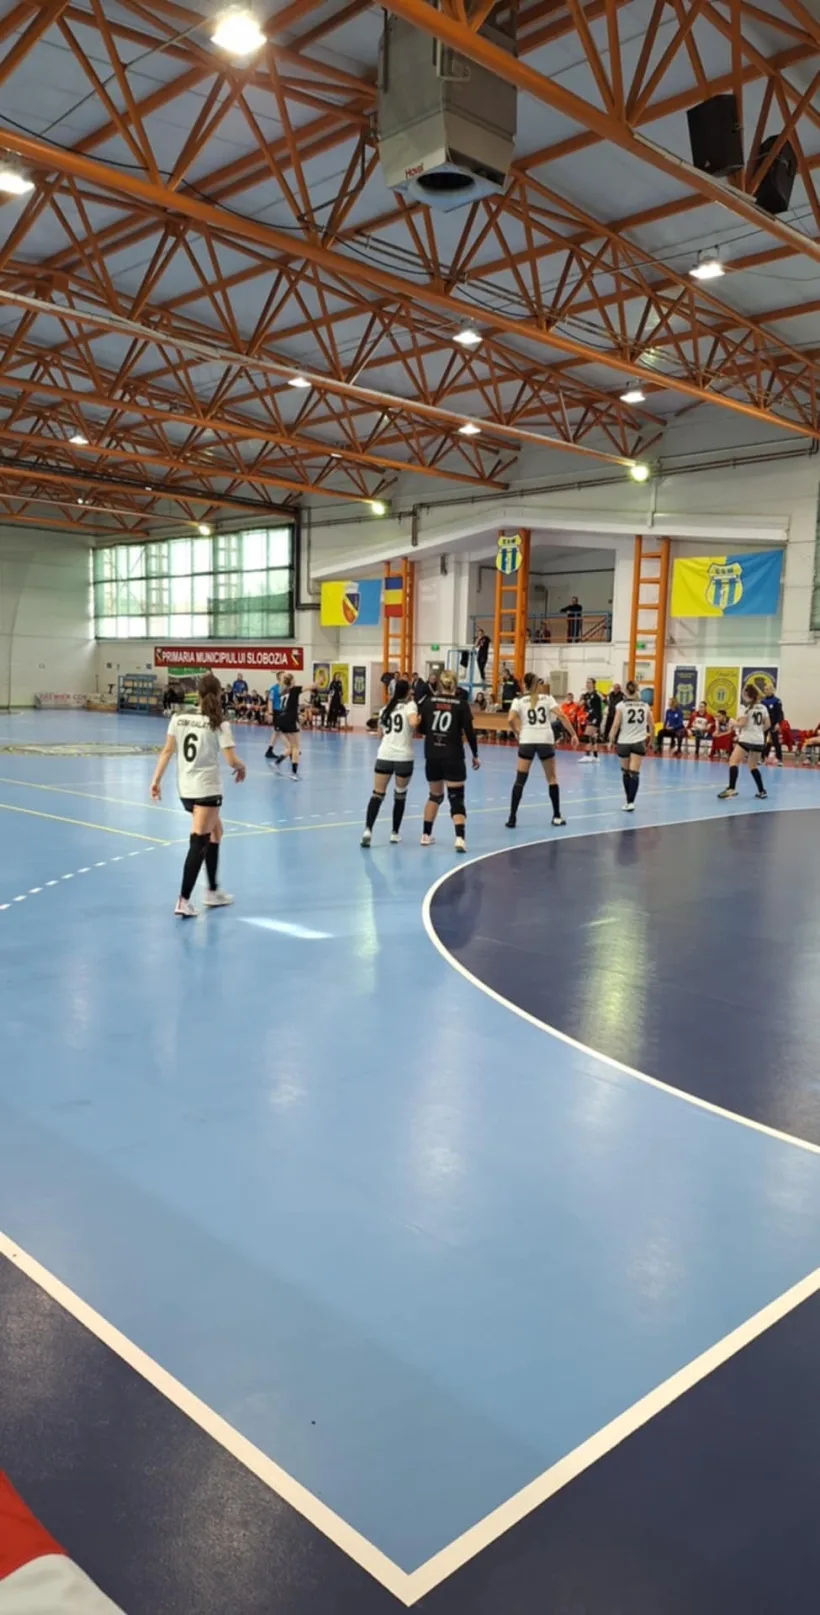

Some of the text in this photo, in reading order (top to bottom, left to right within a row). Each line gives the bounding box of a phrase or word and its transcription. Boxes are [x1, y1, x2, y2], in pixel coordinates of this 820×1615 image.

[162, 651, 288, 665] PRIMARIA MUNICIPIULUI SLOBOZIA
[384, 713, 403, 734] 99
[527, 706, 547, 725] 93
[627, 708, 645, 724] 23
[752, 711, 763, 726] 10
[183, 732, 198, 762] 6
